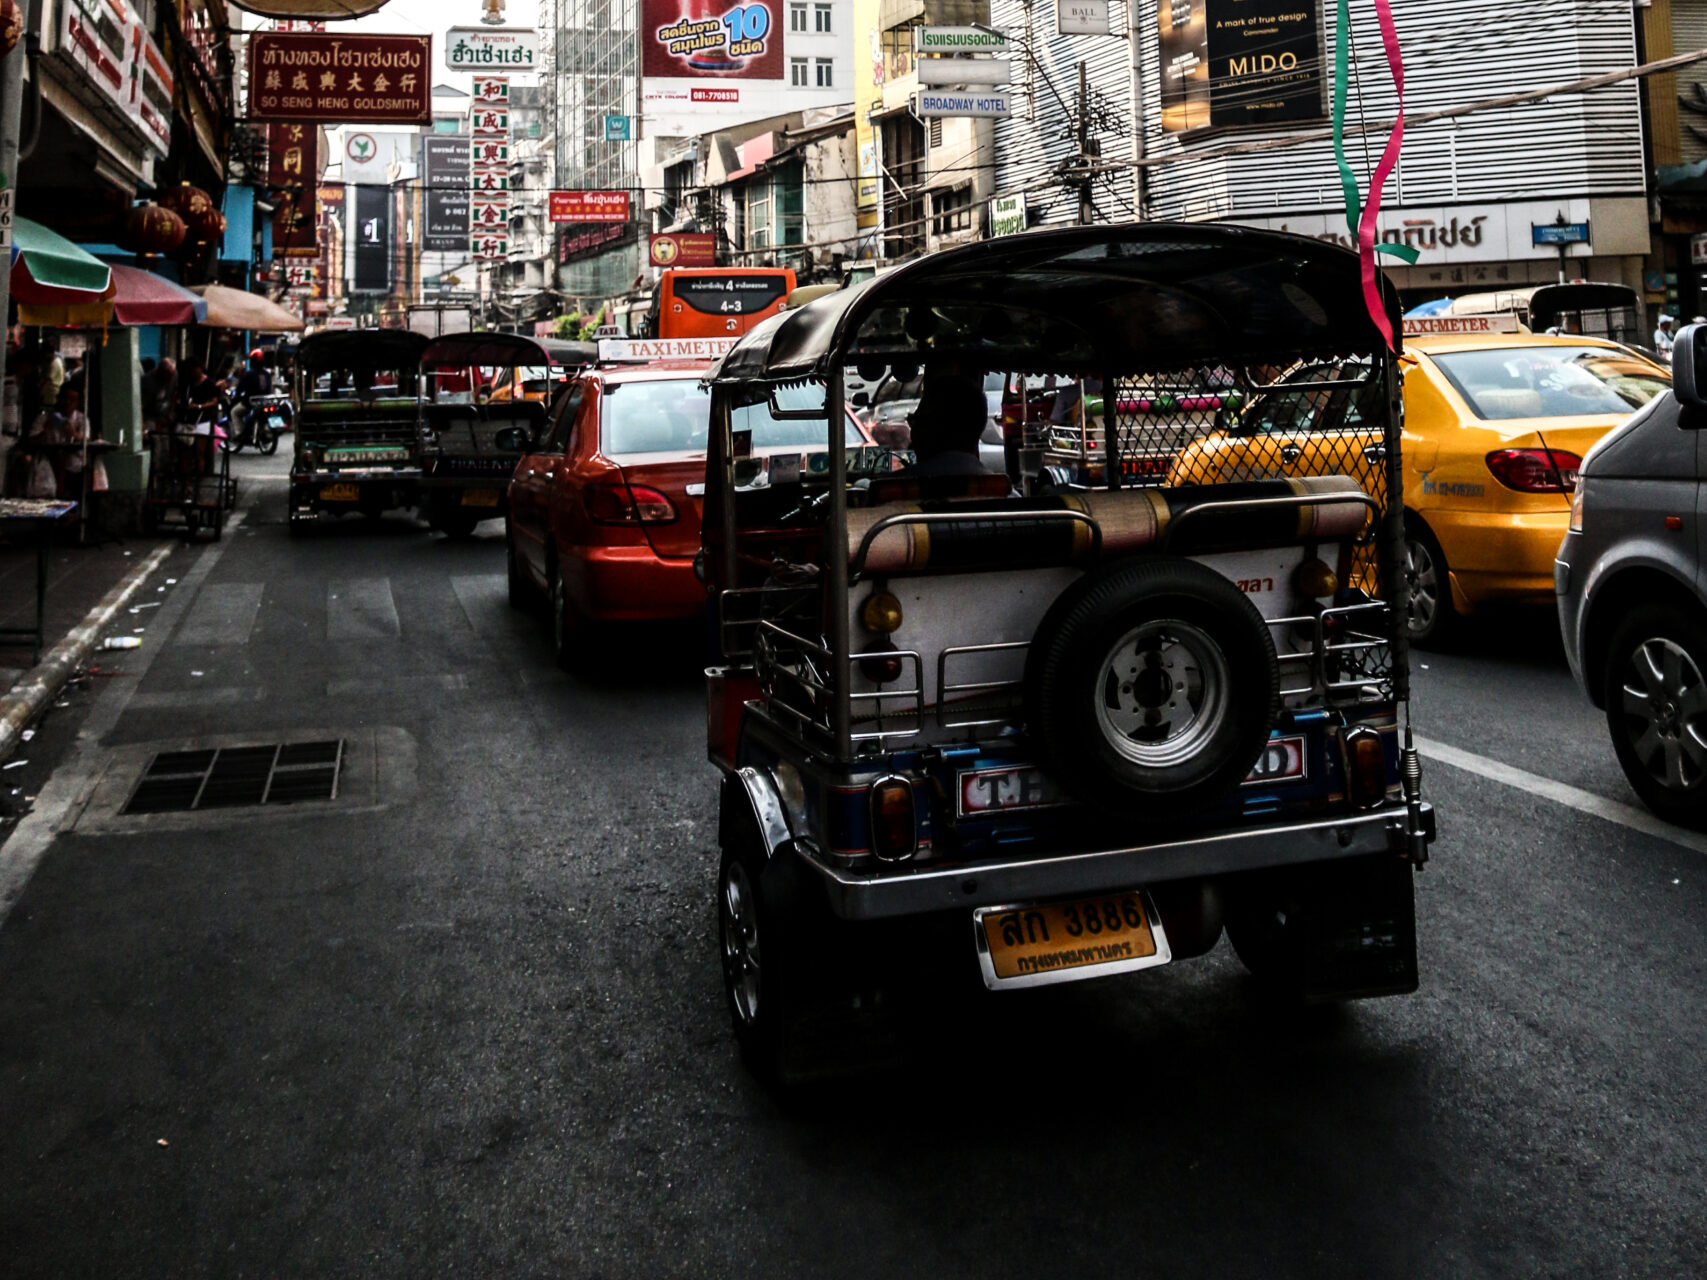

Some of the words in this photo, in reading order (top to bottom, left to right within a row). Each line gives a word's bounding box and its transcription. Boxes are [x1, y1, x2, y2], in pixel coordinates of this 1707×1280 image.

[1072, 8, 1096, 16] BALL
[1225, 19, 1246, 27] mark
[1248, 17, 1256, 25] of
[1278, 13, 1307, 22] design
[660, 21, 719, 40] สดชื่นจาก
[724, 5, 769, 40] 10
[671, 34, 725, 54] สมุนไพร
[730, 39, 763, 56] ชนิด
[1229, 52, 1297, 76] MIDO
[261, 96, 277, 107] SO
[282, 97, 312, 108] SENG
[318, 98, 349, 109] HENG
[354, 98, 419, 110] GOLDSMITH
[923, 97, 974, 110] BROADWAY
[978, 99, 1006, 111] HOTEL
[726, 280, 734, 291] 4
[720, 301, 742, 312] 4-3
[600, 327, 619, 336] TAXI
[1402, 318, 1490, 334] TAXI-METER
[1064, 897, 1142, 937] 3886
[1017, 941, 1133, 972] กรุงเทพมหานคร
